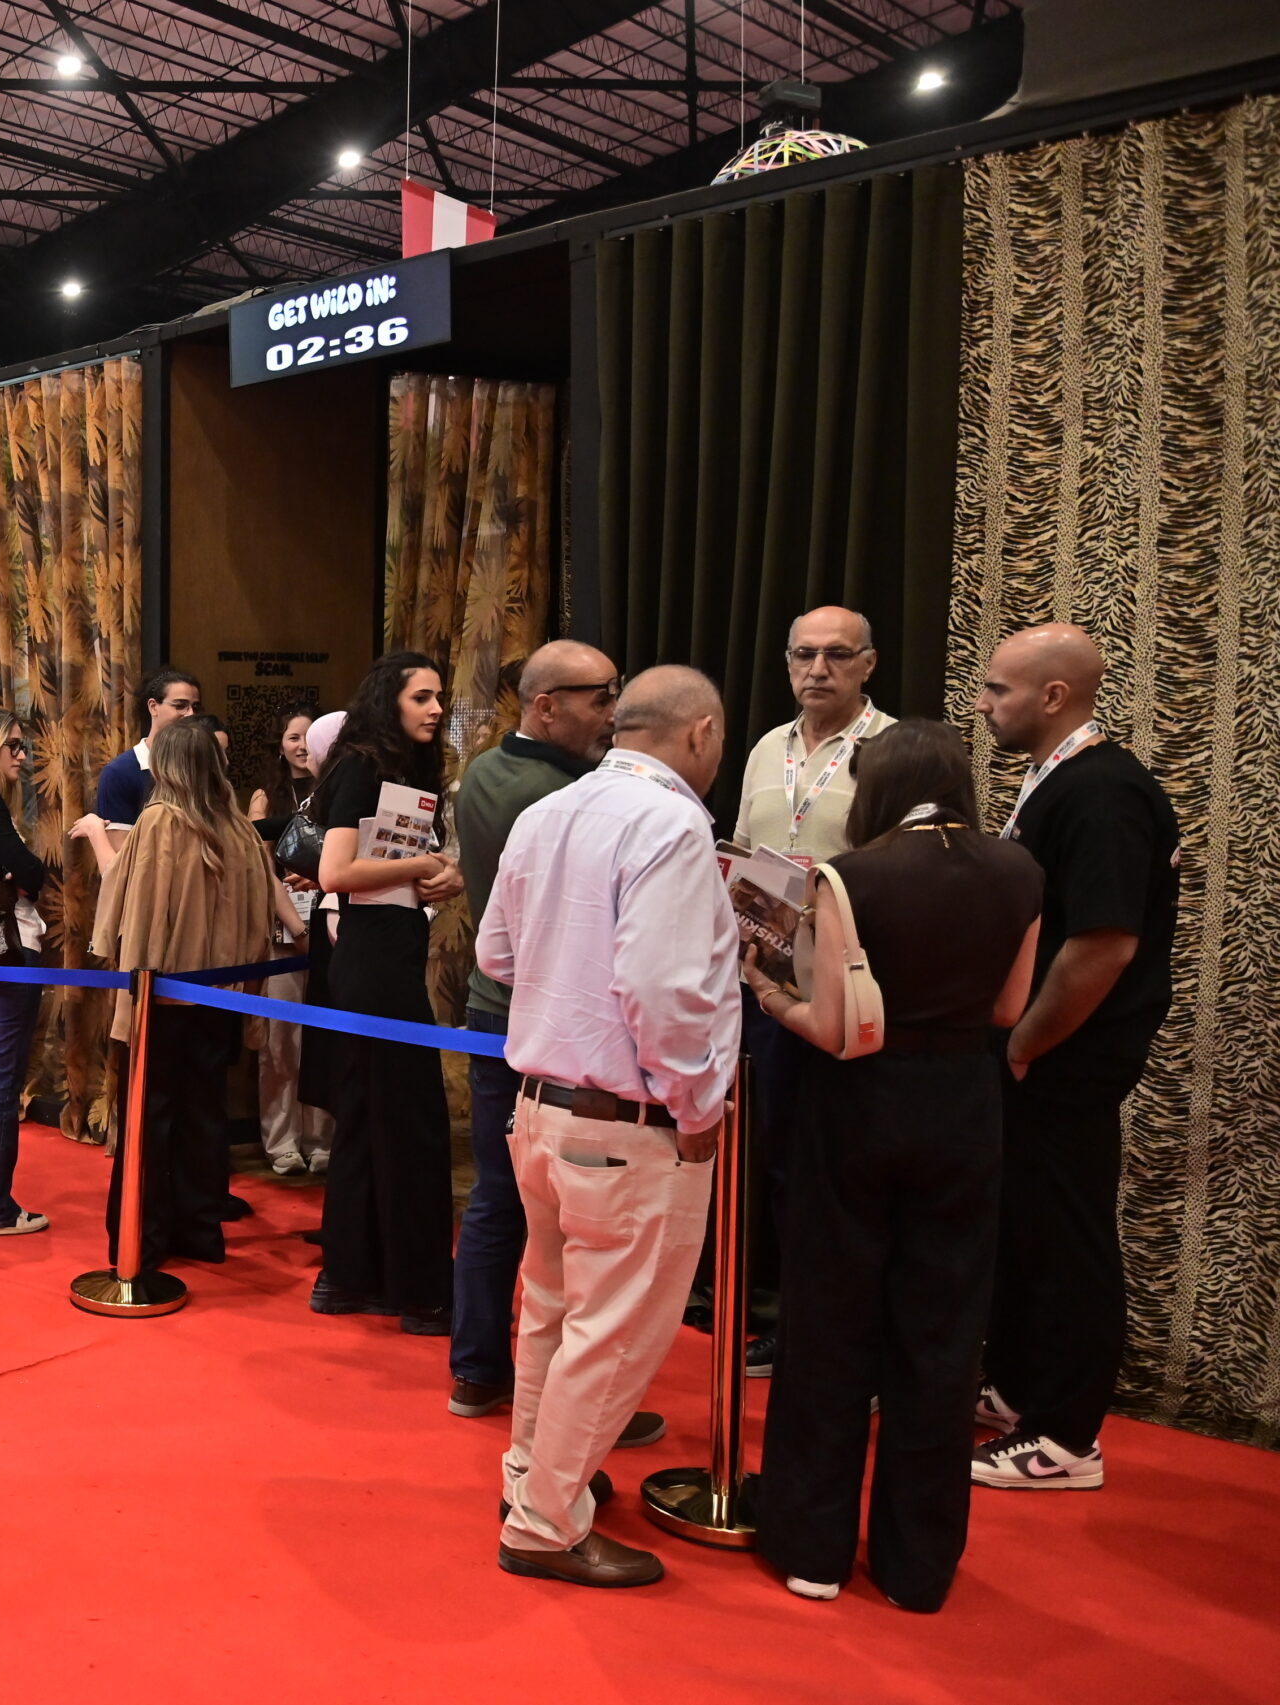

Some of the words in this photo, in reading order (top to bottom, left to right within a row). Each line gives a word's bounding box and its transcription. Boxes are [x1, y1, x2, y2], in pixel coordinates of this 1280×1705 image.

[268, 296, 308, 331] GET
[266, 317, 409, 371] 02:36
[255, 662, 294, 677] SCAN.
